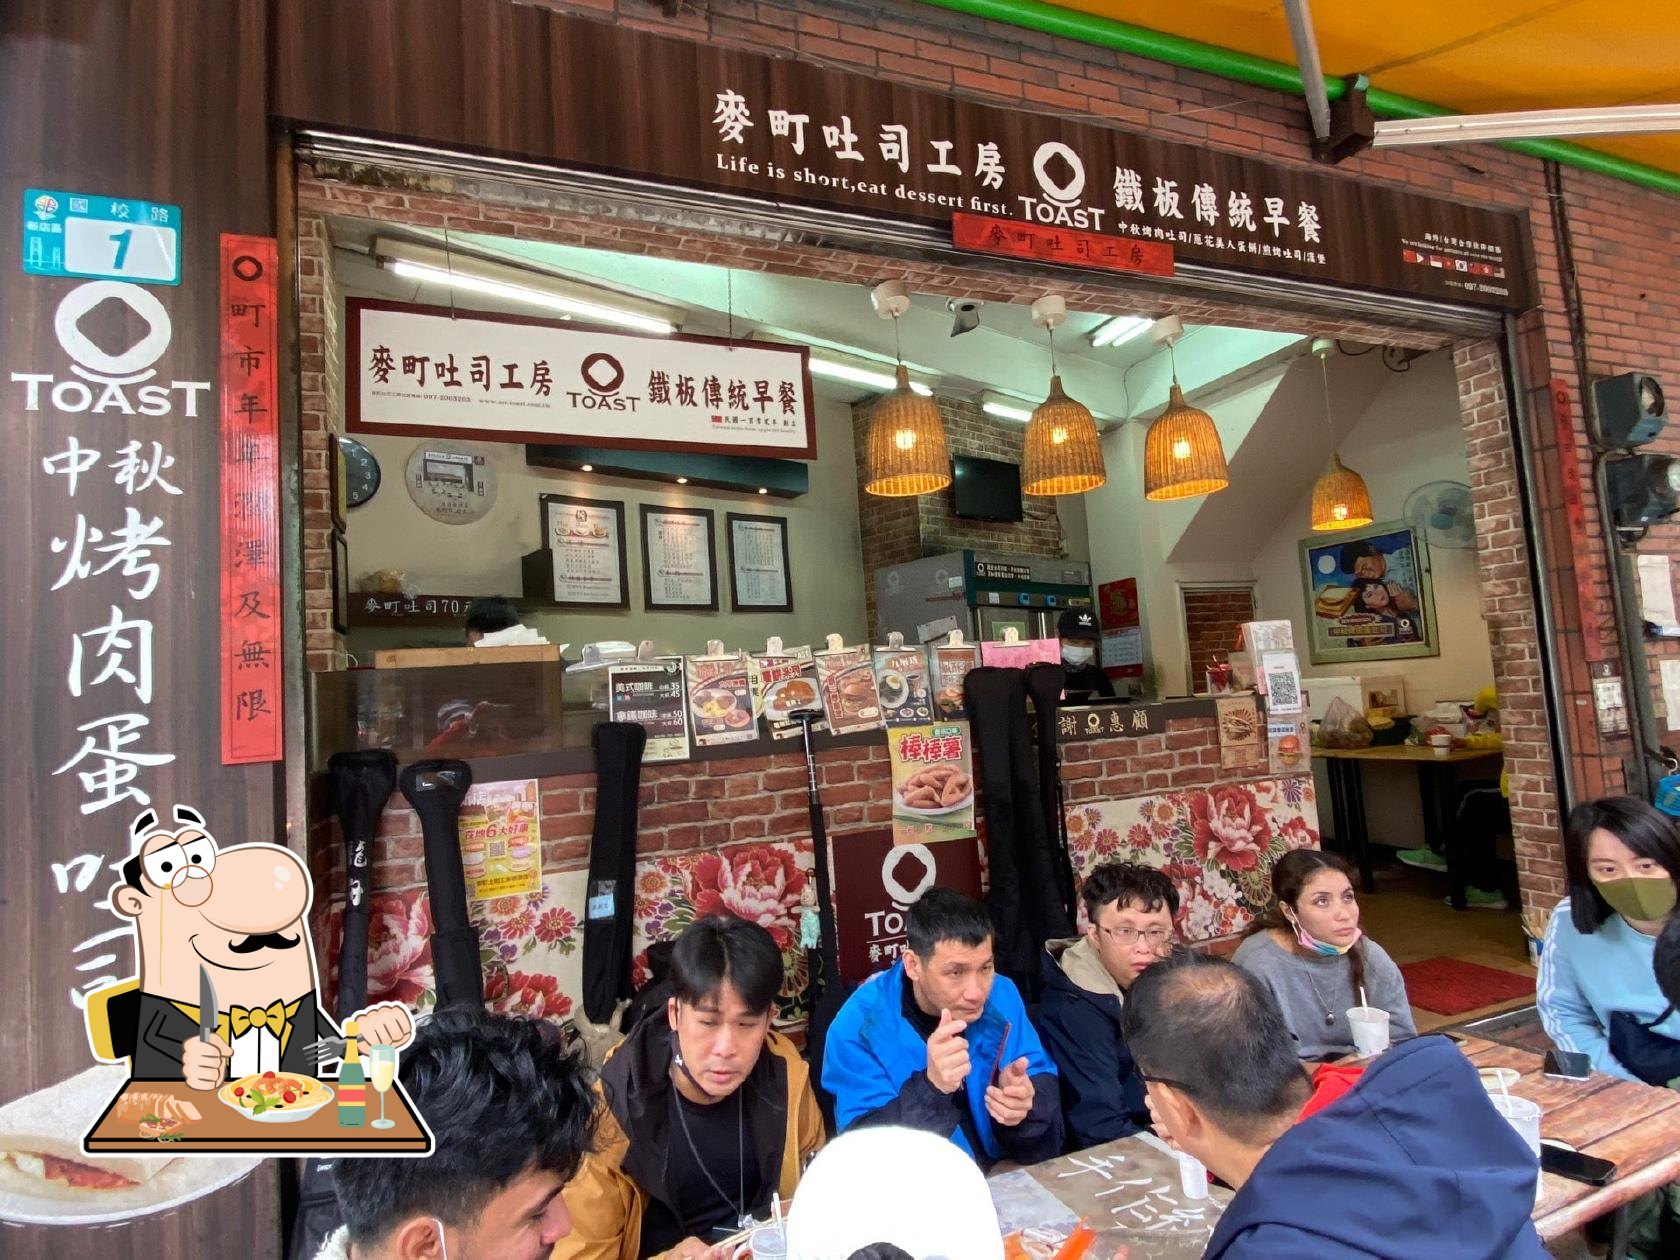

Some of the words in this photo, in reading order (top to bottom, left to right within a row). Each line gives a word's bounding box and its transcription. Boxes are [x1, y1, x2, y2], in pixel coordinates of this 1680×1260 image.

[712, 89, 1006, 190] 麥町吐司工房
[716, 153, 759, 175] Life
[767, 161, 786, 179] is
[894, 184, 964, 208] dessert
[971, 196, 1014, 216] first.
[69, 197, 169, 223] 國校路
[1017, 195, 1106, 232] TOAST
[1112, 165, 1323, 244] 鐵板傳統早餐
[109, 229, 133, 270] 1
[988, 223, 1145, 266] 麥町吐司工房
[370, 344, 554, 397] 麥町吐司工房
[11, 371, 211, 417] TOAST
[566, 390, 641, 414] TOAST
[647, 369, 798, 416] 鐵板傳統早餐
[360, 458, 368, 467] 2
[361, 483, 368, 491] 4
[364, 472, 371, 480] 3
[352, 491, 359, 500] 5
[670, 682, 680, 690] 35
[670, 689, 681, 698] 45
[672, 710, 683, 718] 50
[673, 717, 683, 726] 60
[1057, 714, 1078, 736] 謝
[900, 733, 963, 762] 棒棒薯
